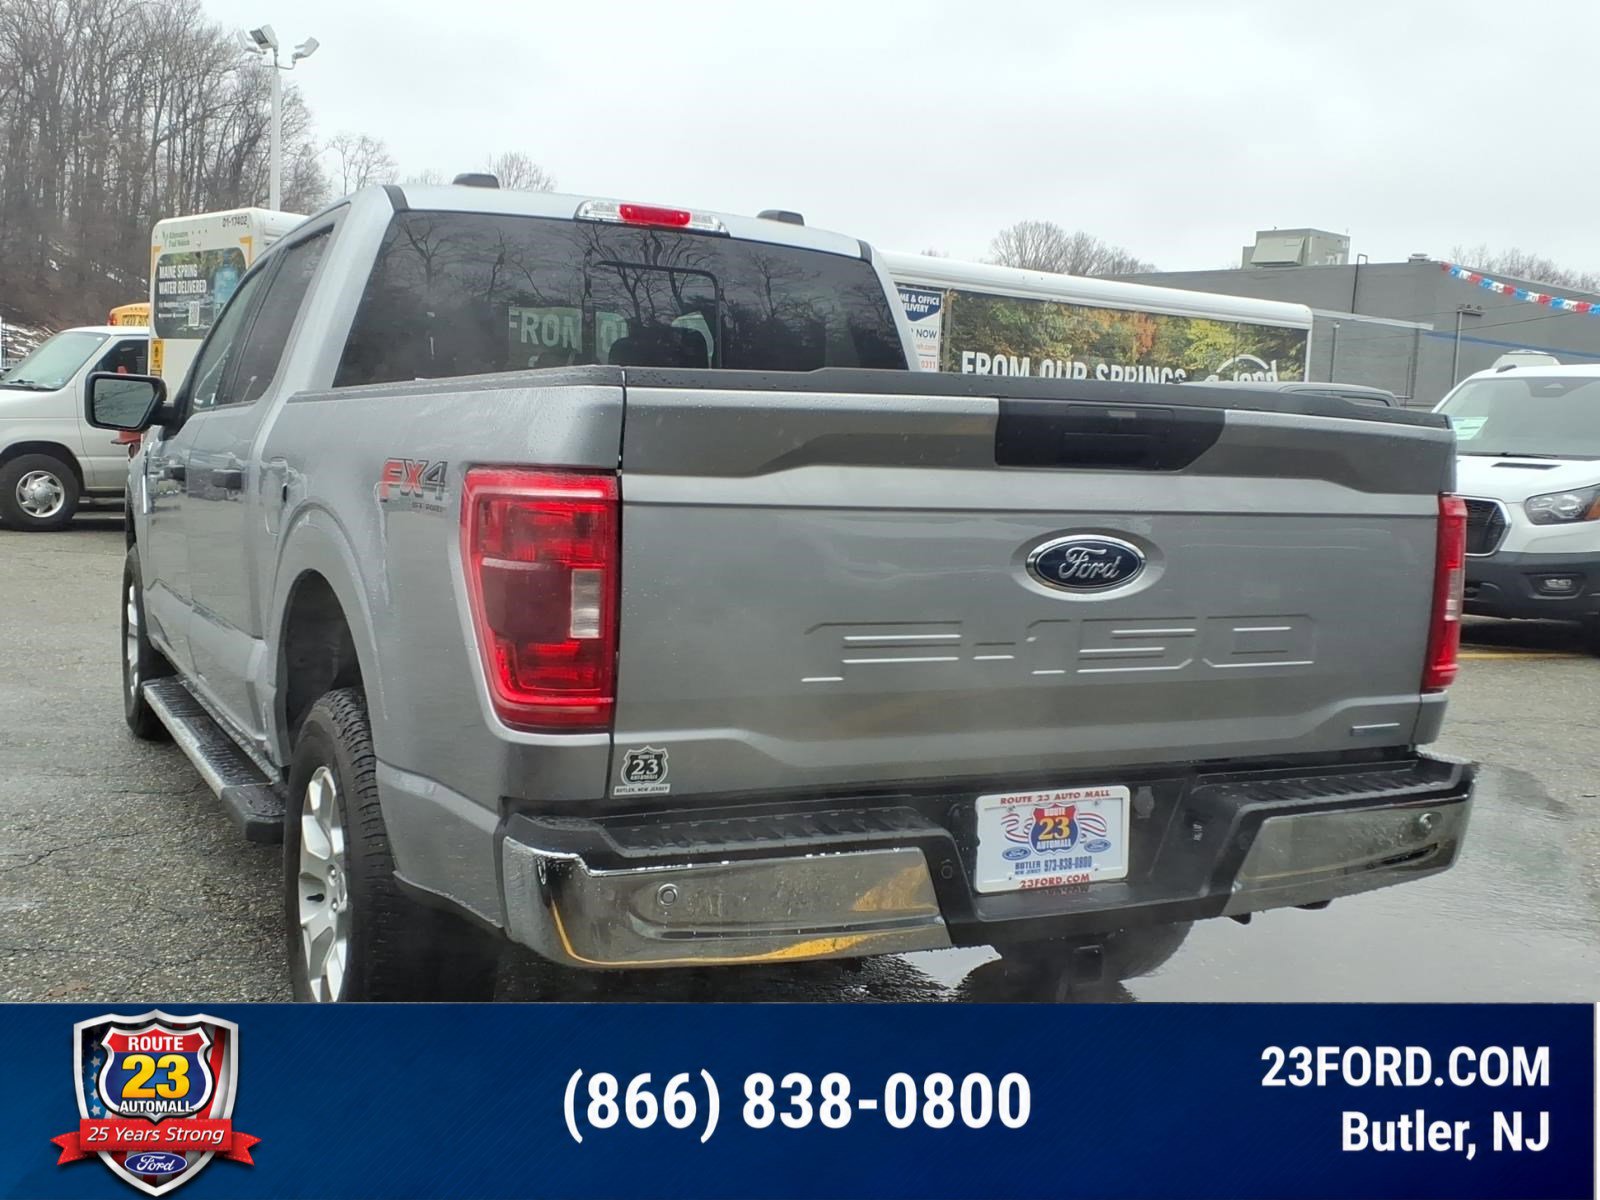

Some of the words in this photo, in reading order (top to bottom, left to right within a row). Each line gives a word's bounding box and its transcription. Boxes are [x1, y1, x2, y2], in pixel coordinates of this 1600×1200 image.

[159, 265, 177, 279] MAINE
[177, 263, 198, 278] SPRING
[159, 281, 177, 295] WATER
[178, 279, 207, 294] DELIVERED
[911, 294, 917, 303] &
[918, 295, 940, 306] OFFICE
[916, 329, 937, 339] NOW
[379, 456, 448, 502] FX4
[1058, 546, 1121, 579] Ford
[800, 613, 1316, 682] F-150
[631, 759, 659, 775] 23
[1000, 795, 1033, 805] ROUTE
[1037, 794, 1050, 802] 23
[1054, 791, 1081, 801] AUTO
[1084, 789, 1110, 798] MALL
[1038, 816, 1071, 841] 23
[1015, 860, 1041, 870] BUTLER
[1020, 873, 1090, 889] 23FORD.COM
